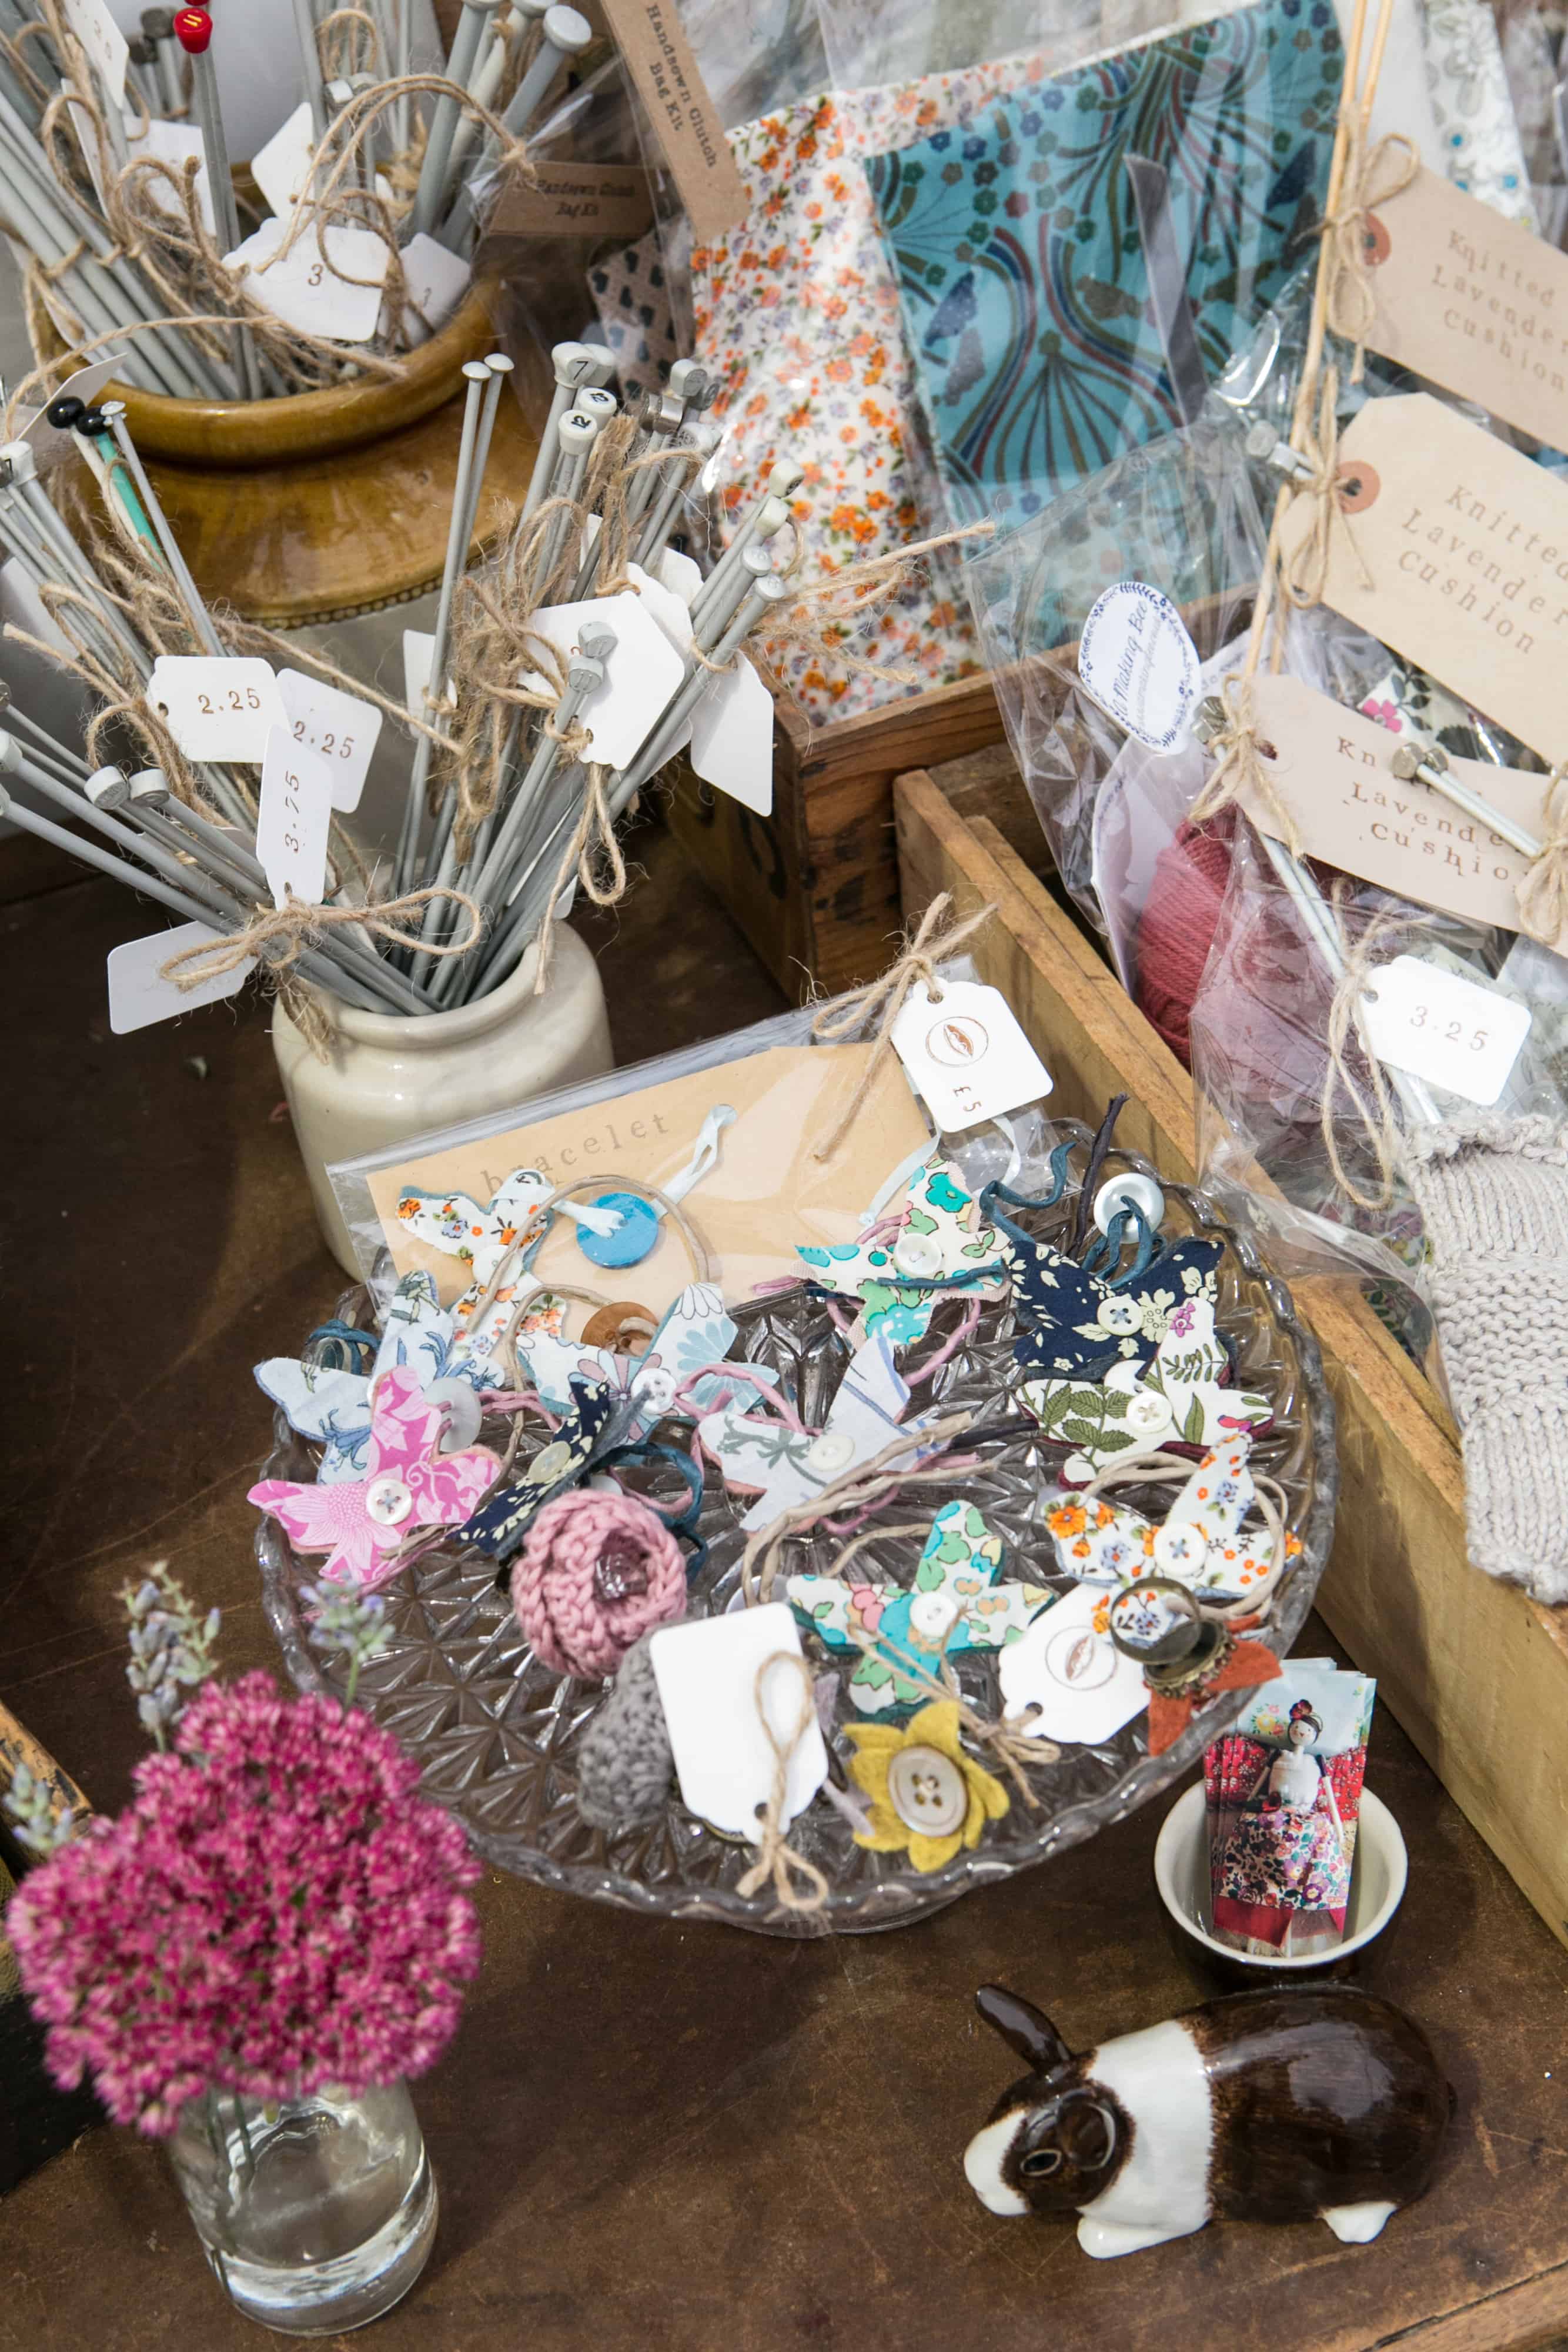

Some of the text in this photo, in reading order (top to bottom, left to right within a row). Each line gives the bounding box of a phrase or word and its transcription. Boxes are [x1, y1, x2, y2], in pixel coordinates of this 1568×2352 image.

[647, 4, 717, 168] Handsewn Clutch
[650, 62, 684, 131] Bag Kit
[1444, 308, 1565, 392] Cushion
[1398, 550, 1534, 654] Cushion
[198, 687, 261, 714] 2.25
[293, 720, 355, 759] 2.25
[285, 770, 300, 854] 3.75
[1352, 781, 1522, 853] Lavende
[1370, 822, 1527, 881] Cushio
[1409, 1005, 1489, 1051] 3.25
[480, 1114, 669, 1197] bacelet
